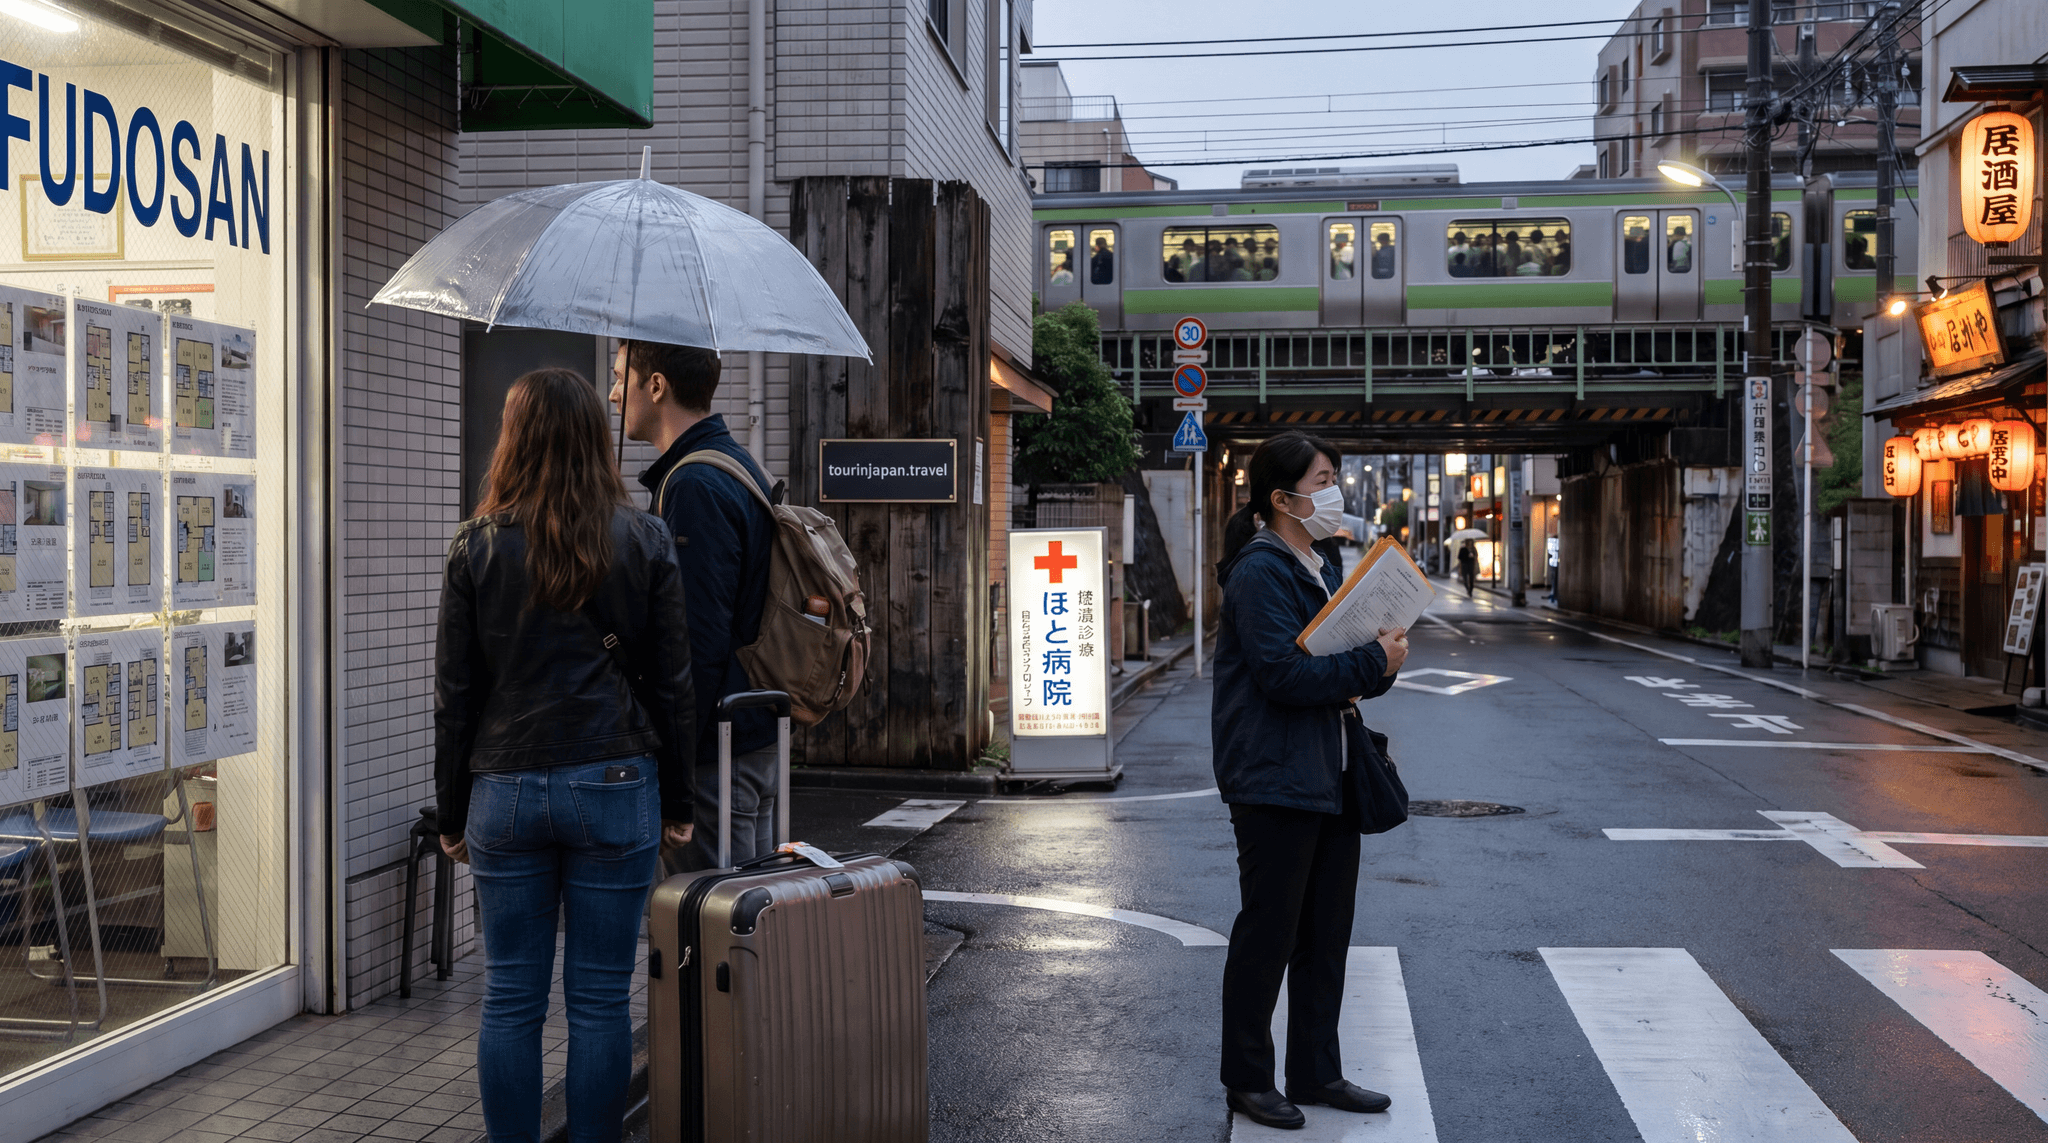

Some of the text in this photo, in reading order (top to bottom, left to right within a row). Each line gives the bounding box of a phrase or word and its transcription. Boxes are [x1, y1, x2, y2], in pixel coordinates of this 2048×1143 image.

[0, 59, 270, 255] FUDOSAN
[1980, 124, 2019, 226] 居酒屋
[1182, 325, 1199, 342] 30
[828, 463, 948, 480] tourinjapan.travel
[1042, 591, 1072, 706] ほと病院
